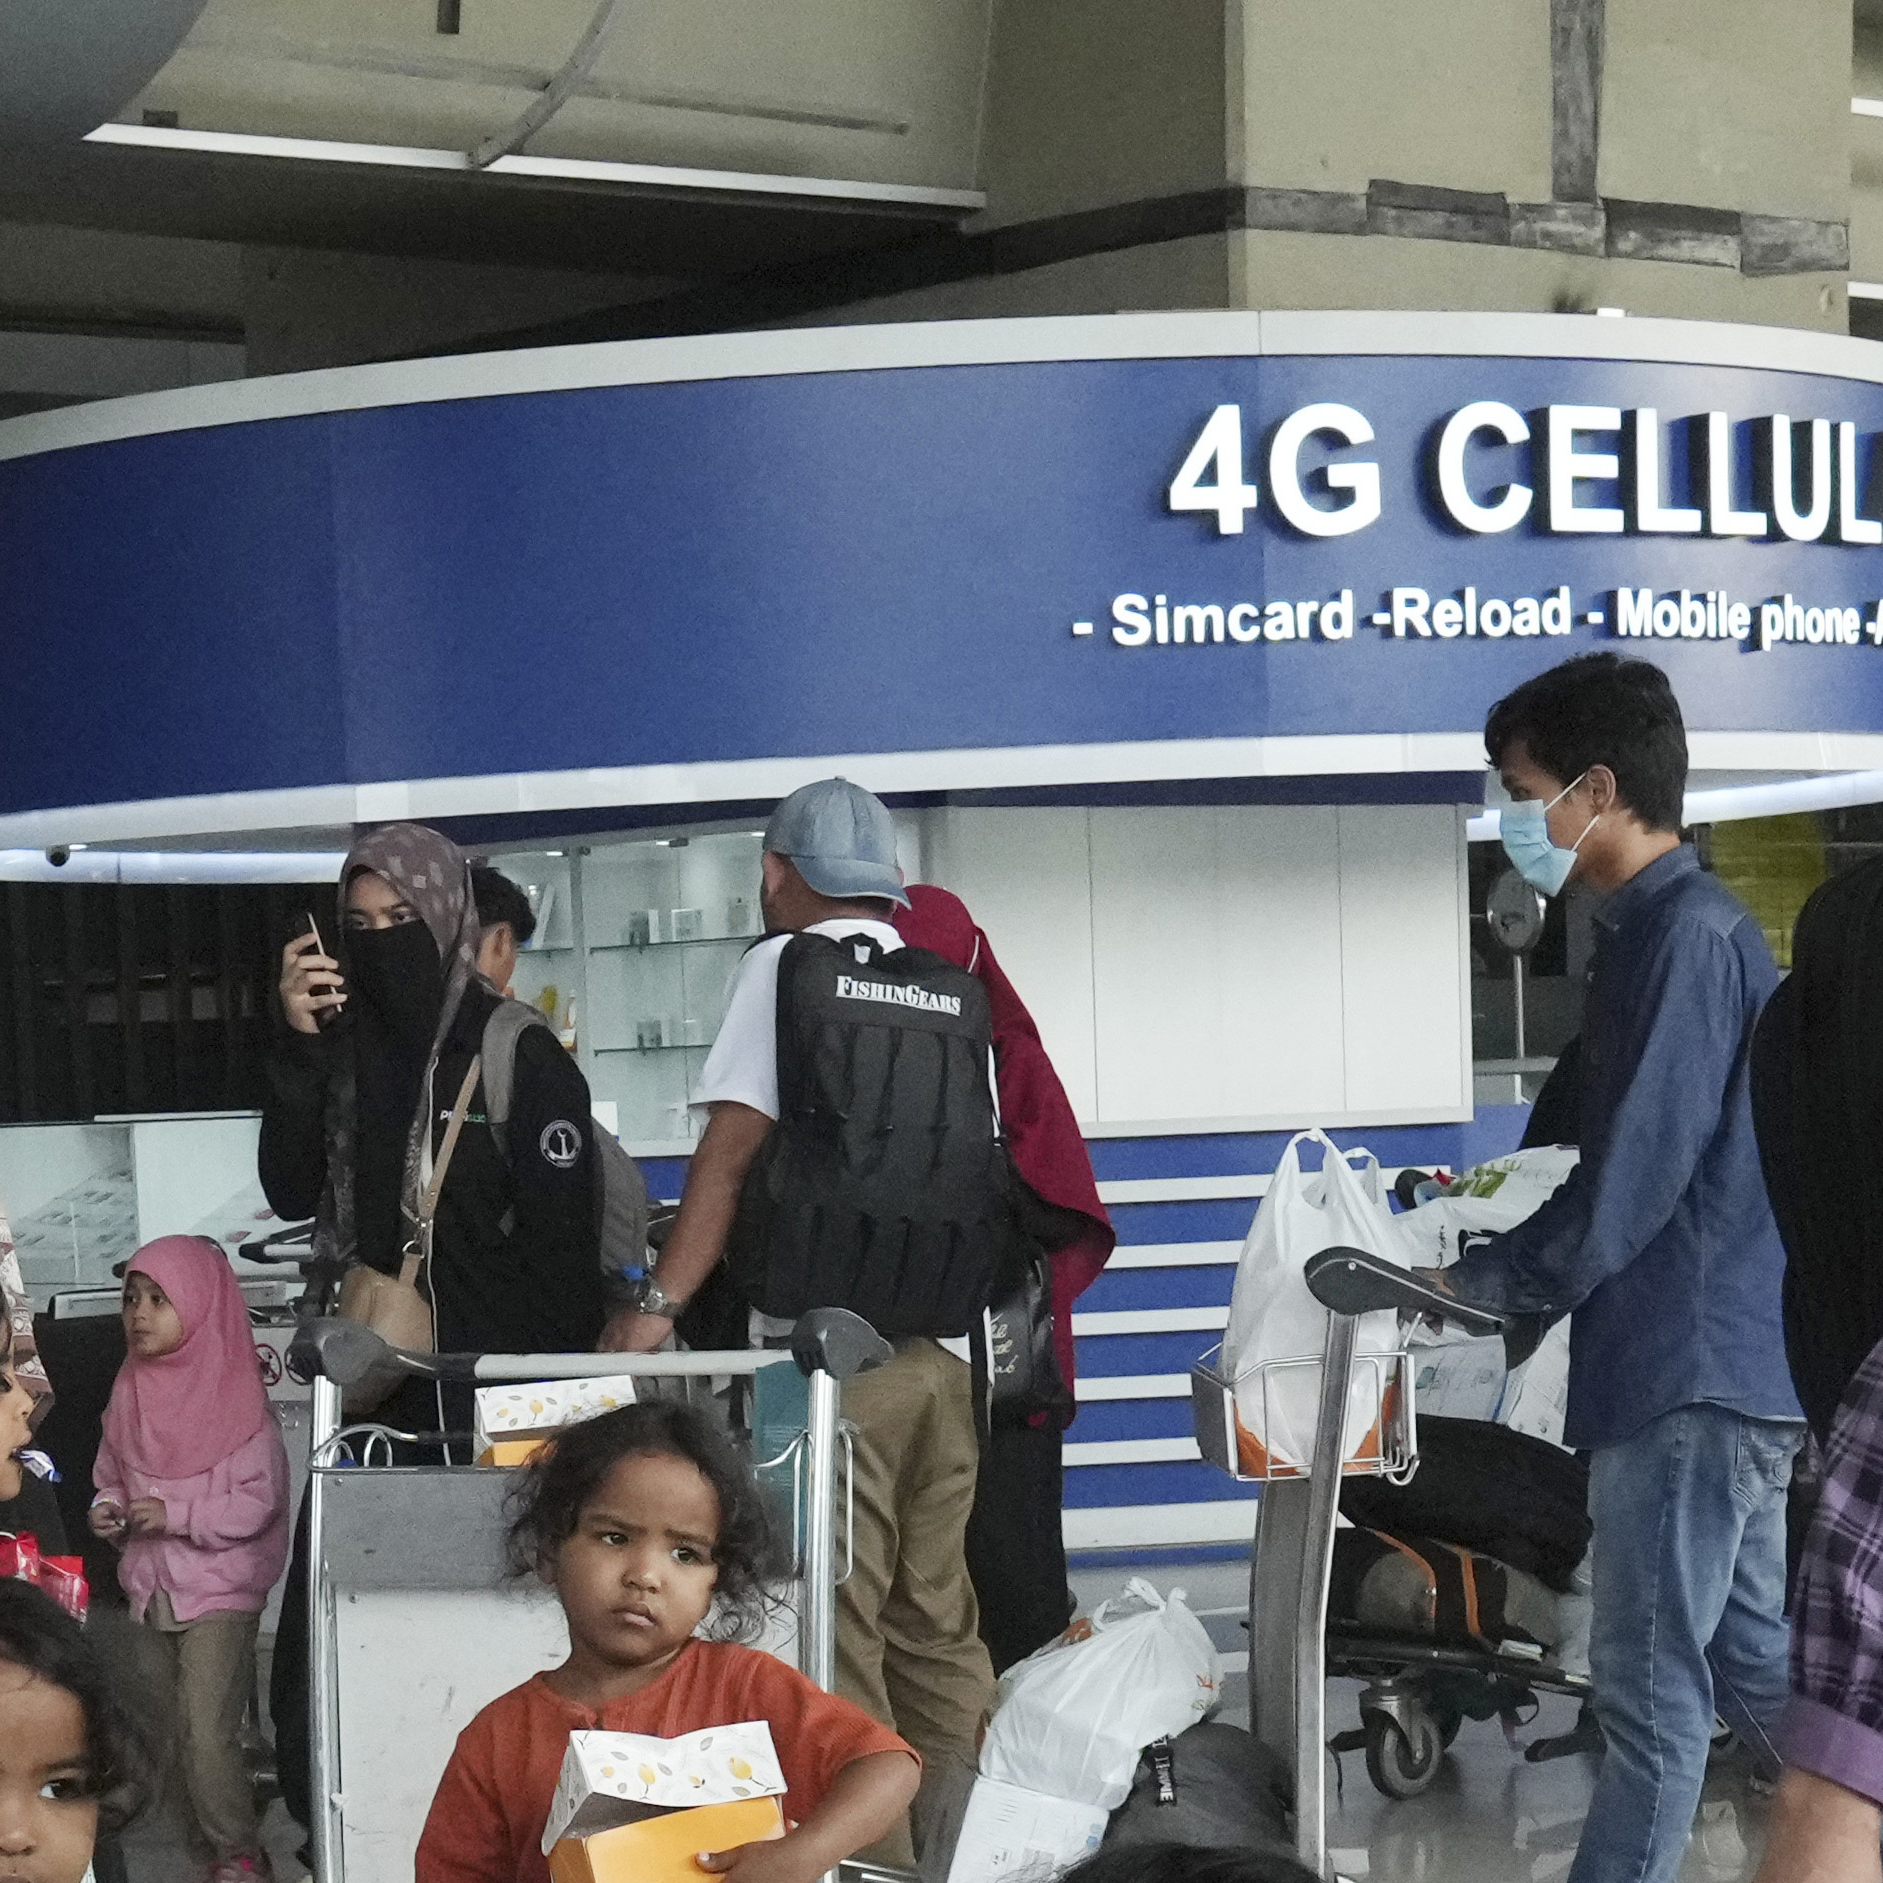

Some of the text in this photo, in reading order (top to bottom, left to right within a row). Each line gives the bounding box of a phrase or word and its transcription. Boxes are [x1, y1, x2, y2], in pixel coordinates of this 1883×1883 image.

[1169, 402, 1382, 537] 4G
[1111, 588, 1354, 646] Simcard
[1618, 587, 1751, 639] Mobile
[1761, 593, 1861, 652] phone
